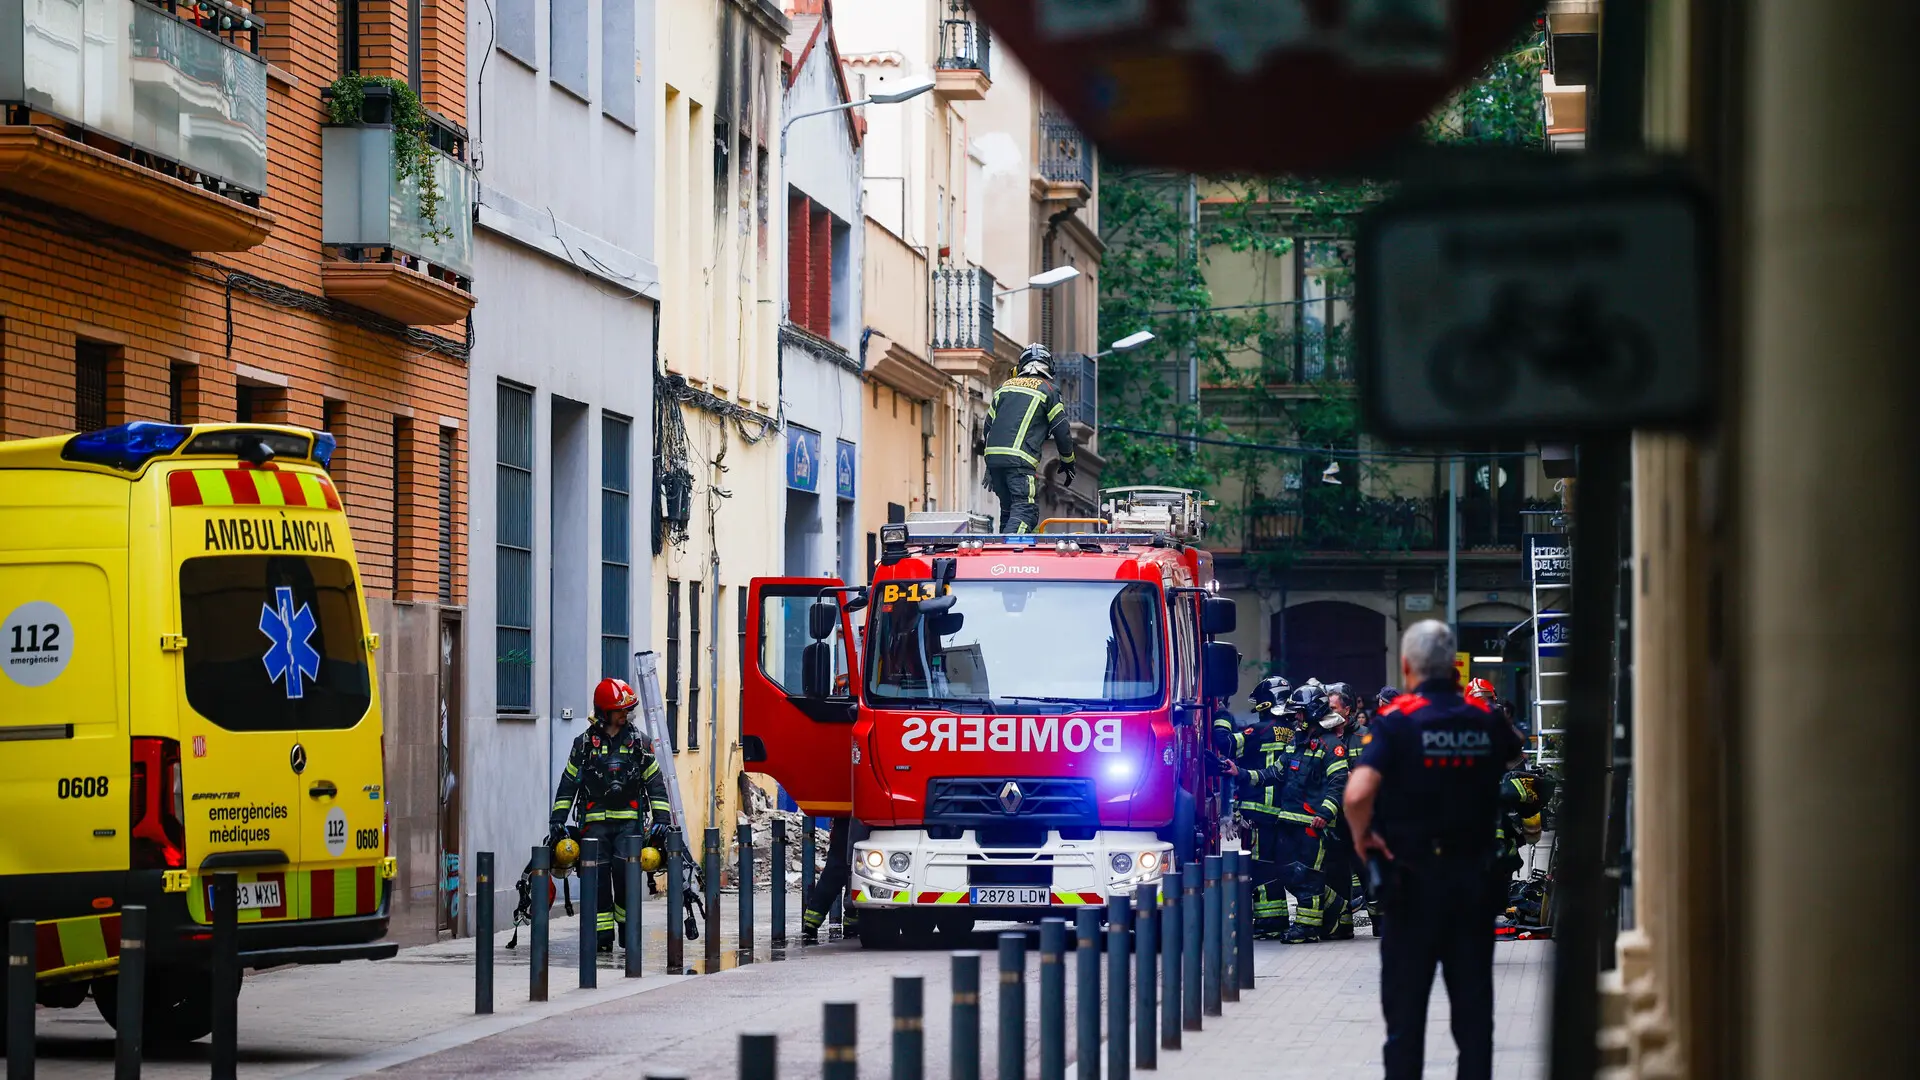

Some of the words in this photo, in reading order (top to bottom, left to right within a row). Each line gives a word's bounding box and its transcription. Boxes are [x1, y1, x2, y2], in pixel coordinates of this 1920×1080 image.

[205, 510, 336, 553] AMBULÀNCIA
[1008, 566, 1040, 574] ITURRI
[1535, 560, 1552, 570] DEL
[11, 623, 60, 653] 112
[1484, 640, 1506, 650] 179
[10, 655, 59, 665] emergències
[1422, 730, 1490, 747] POLICIA
[58, 776, 109, 799] 0608
[191, 791, 240, 800] SPRINTER
[209, 802, 288, 824] emergències
[209, 825, 270, 846] mèdiques
[328, 820, 344, 837] 112
[356, 828, 379, 849] 0608
[254, 884, 279, 904] MXH
[980, 890, 1015, 903] 2878
[1020, 890, 1046, 903] LDW
